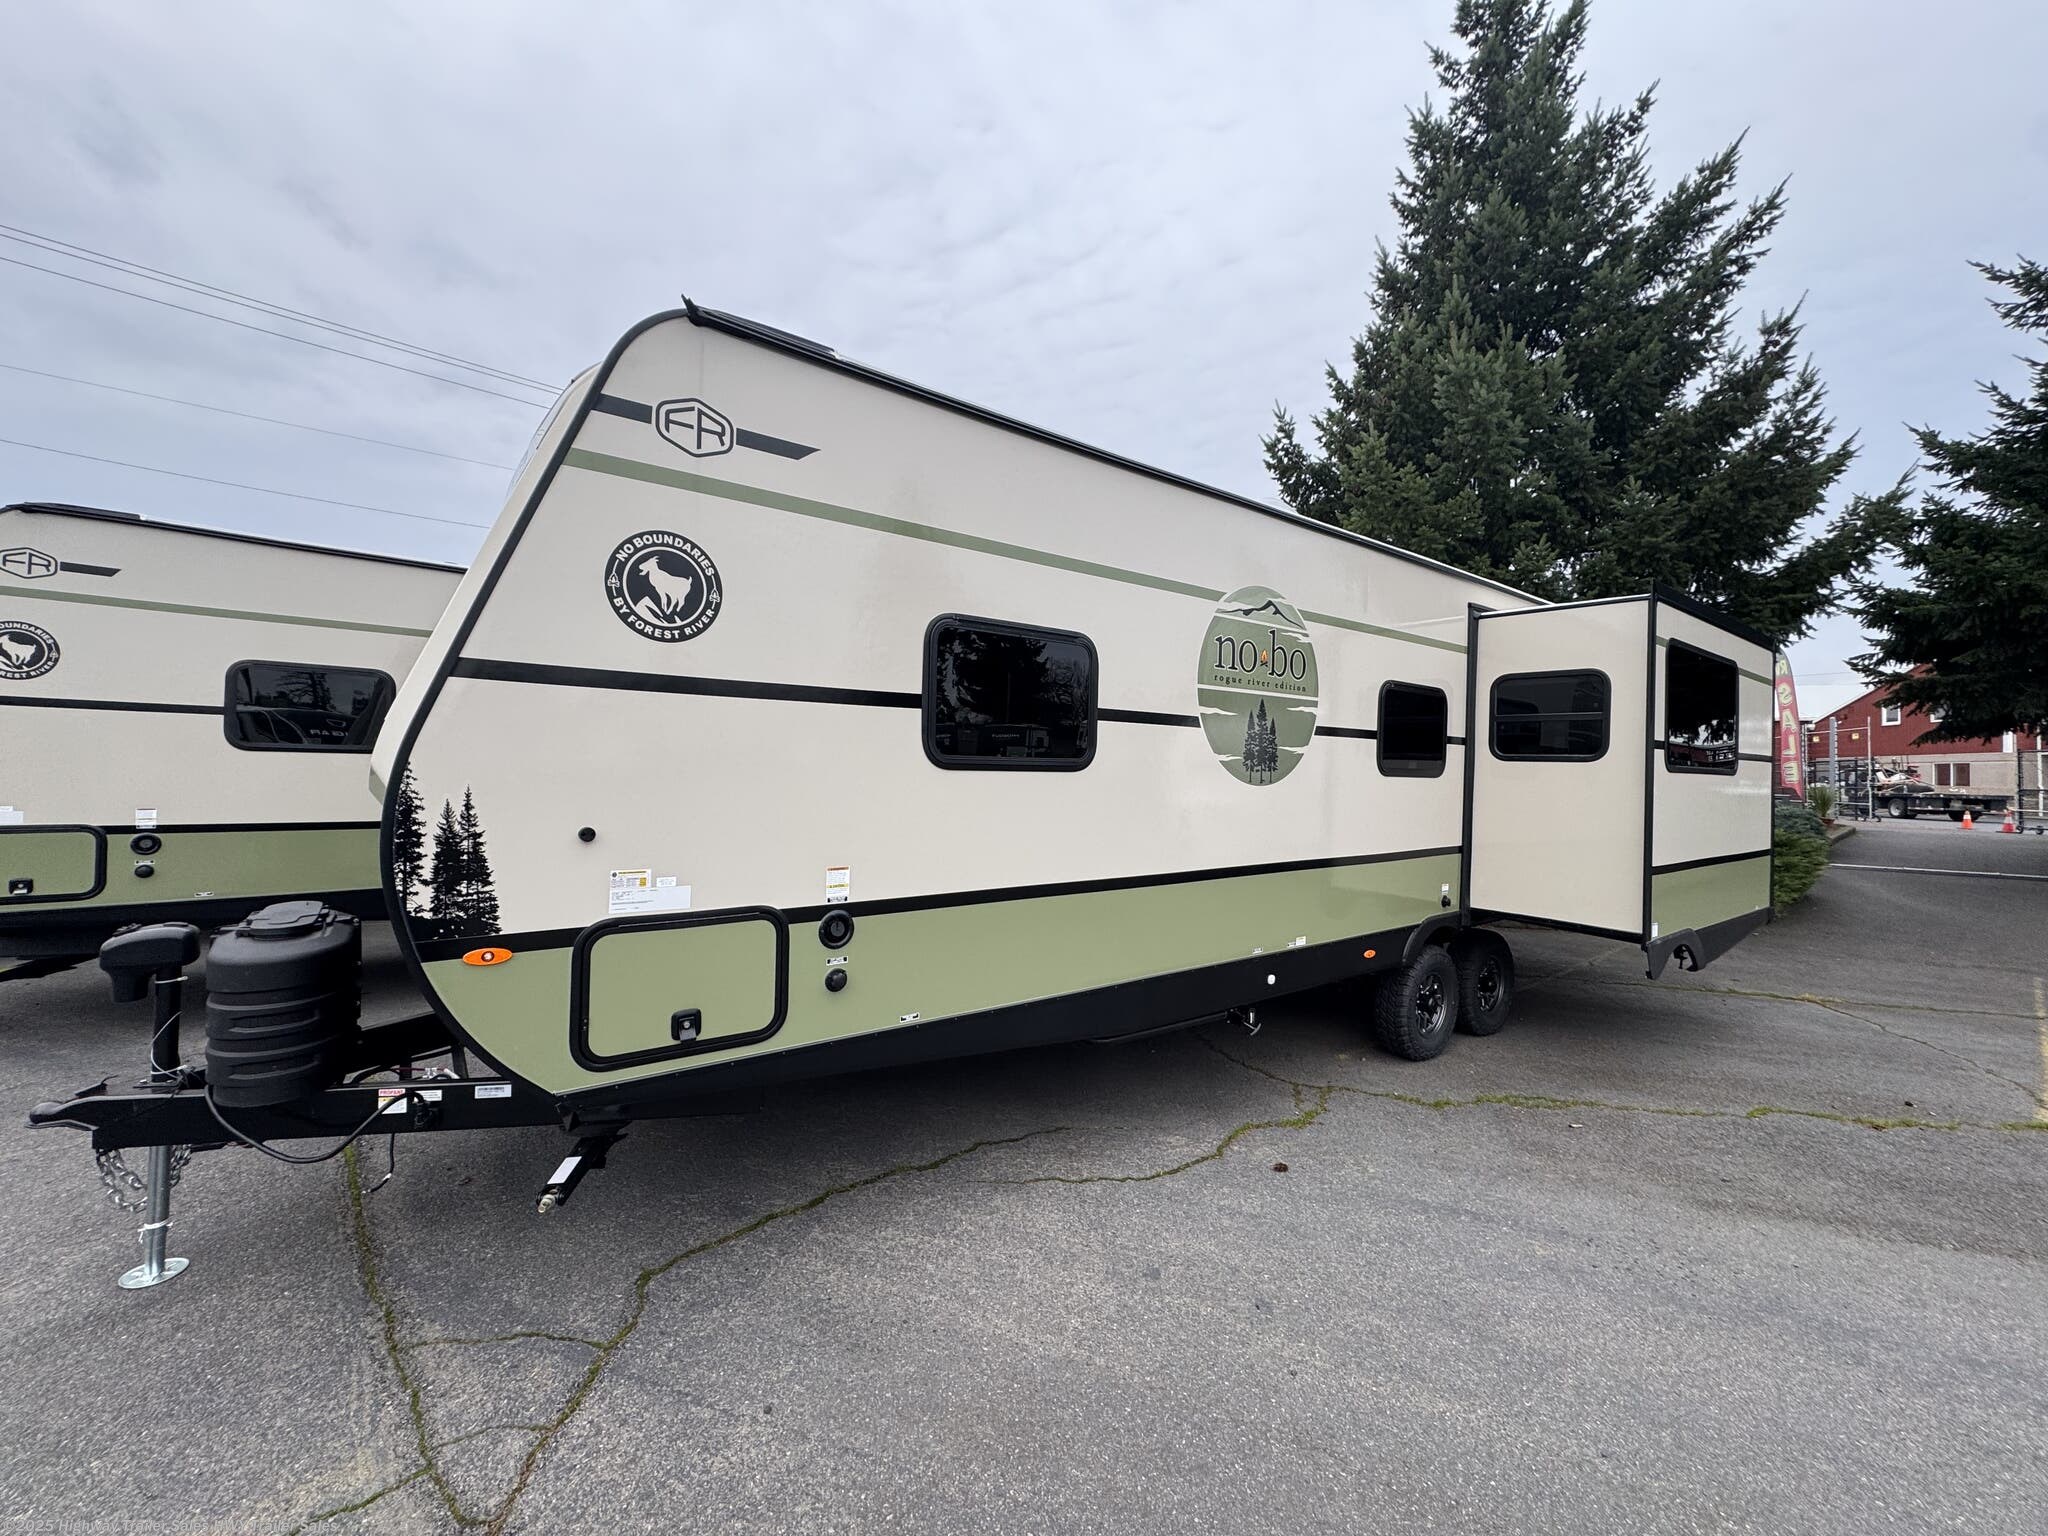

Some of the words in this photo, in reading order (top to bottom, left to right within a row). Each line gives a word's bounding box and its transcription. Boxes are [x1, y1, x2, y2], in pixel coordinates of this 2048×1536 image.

[615, 543, 635, 562] NO
[632, 533, 715, 577] BOUNDARIES
[613, 597, 630, 614] BY
[627, 614, 681, 639] FOREST
[683, 608, 715, 636] RIVER
[1213, 674, 1242, 685] rogue
[1247, 678, 1271, 688] river
[1275, 681, 1306, 692] edition
